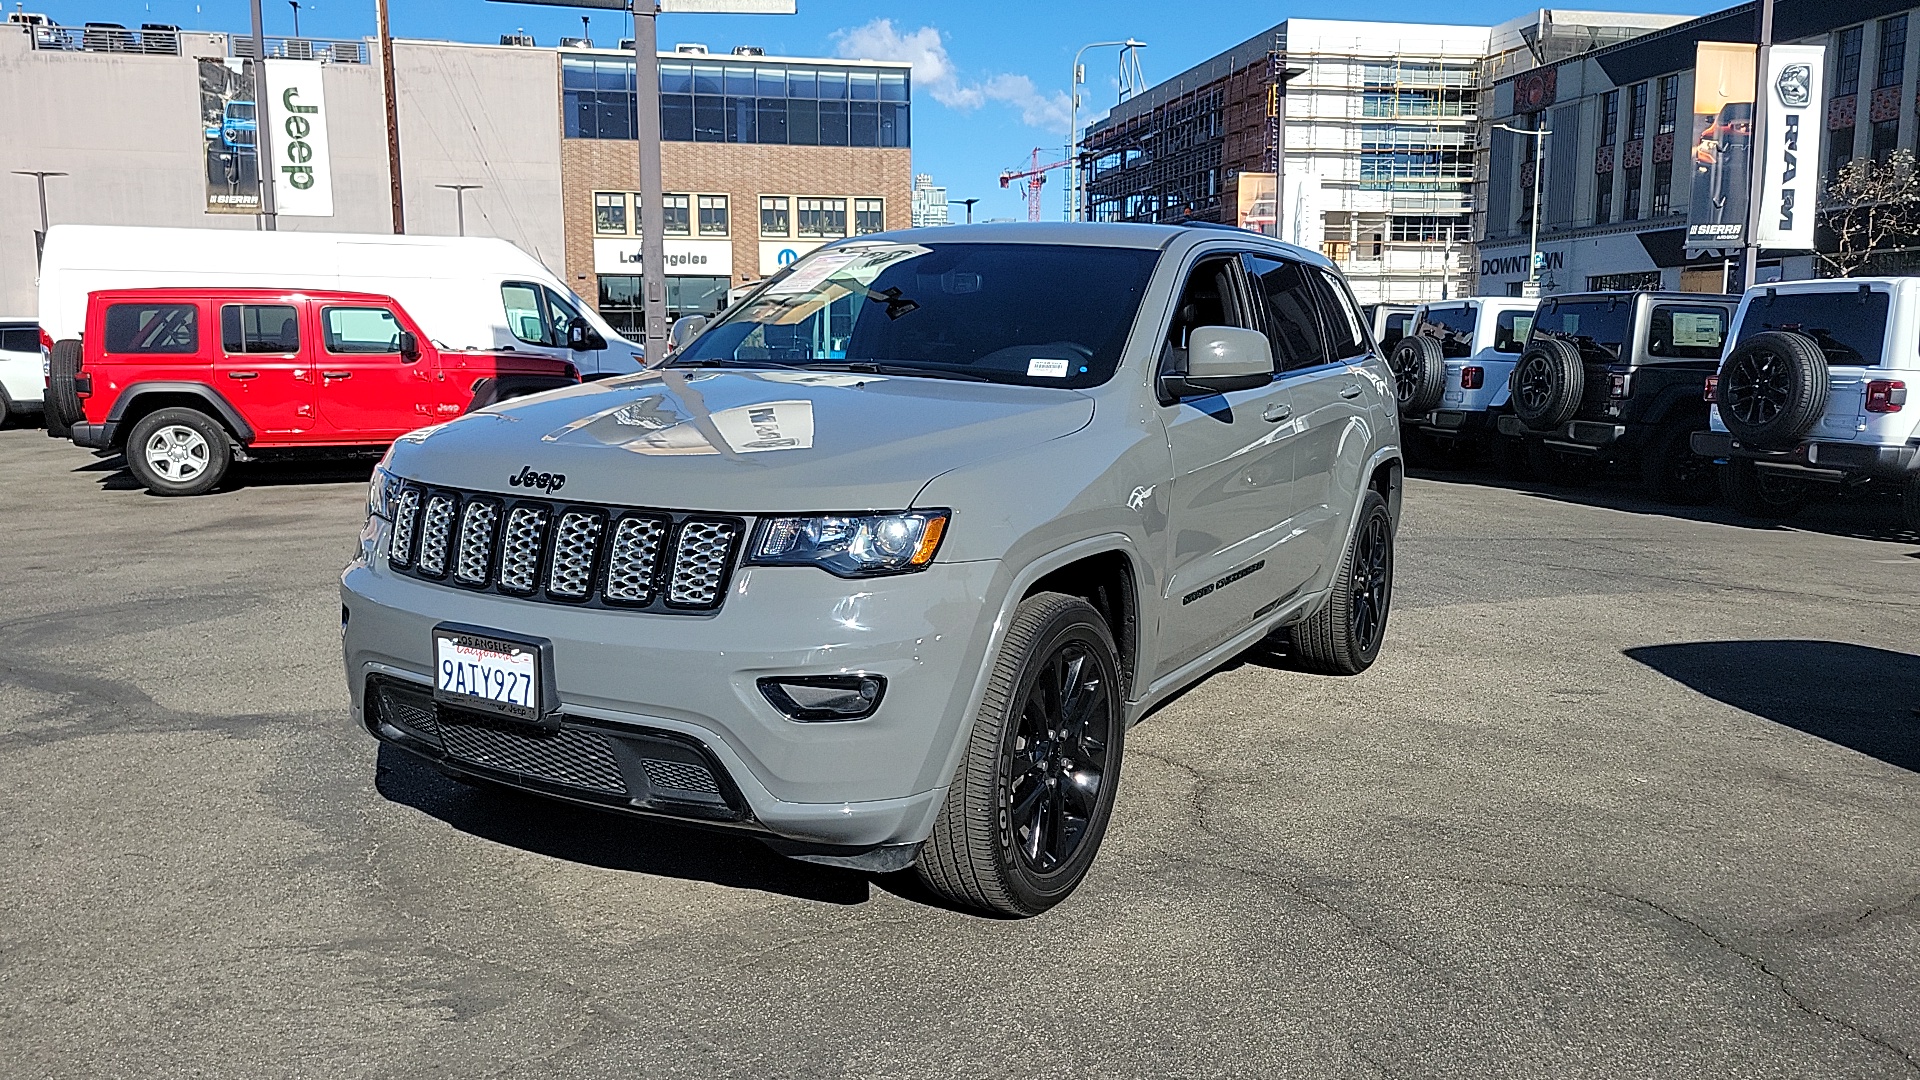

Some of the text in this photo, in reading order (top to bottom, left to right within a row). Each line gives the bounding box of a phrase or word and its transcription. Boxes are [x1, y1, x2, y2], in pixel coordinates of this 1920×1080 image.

[281, 87, 318, 190] Jeep
[1779, 115, 1799, 230] RAM
[217, 195, 258, 204] SIERRA
[1697, 224, 1742, 234] SIERRA
[662, 251, 707, 266] ngeles
[1481, 251, 1564, 276] DOWNTWN
[437, 403, 460, 412] Jeep
[509, 465, 566, 495] Jeep
[457, 636, 512, 653] LOS ANGELES
[442, 659, 531, 707] 9AIY927
